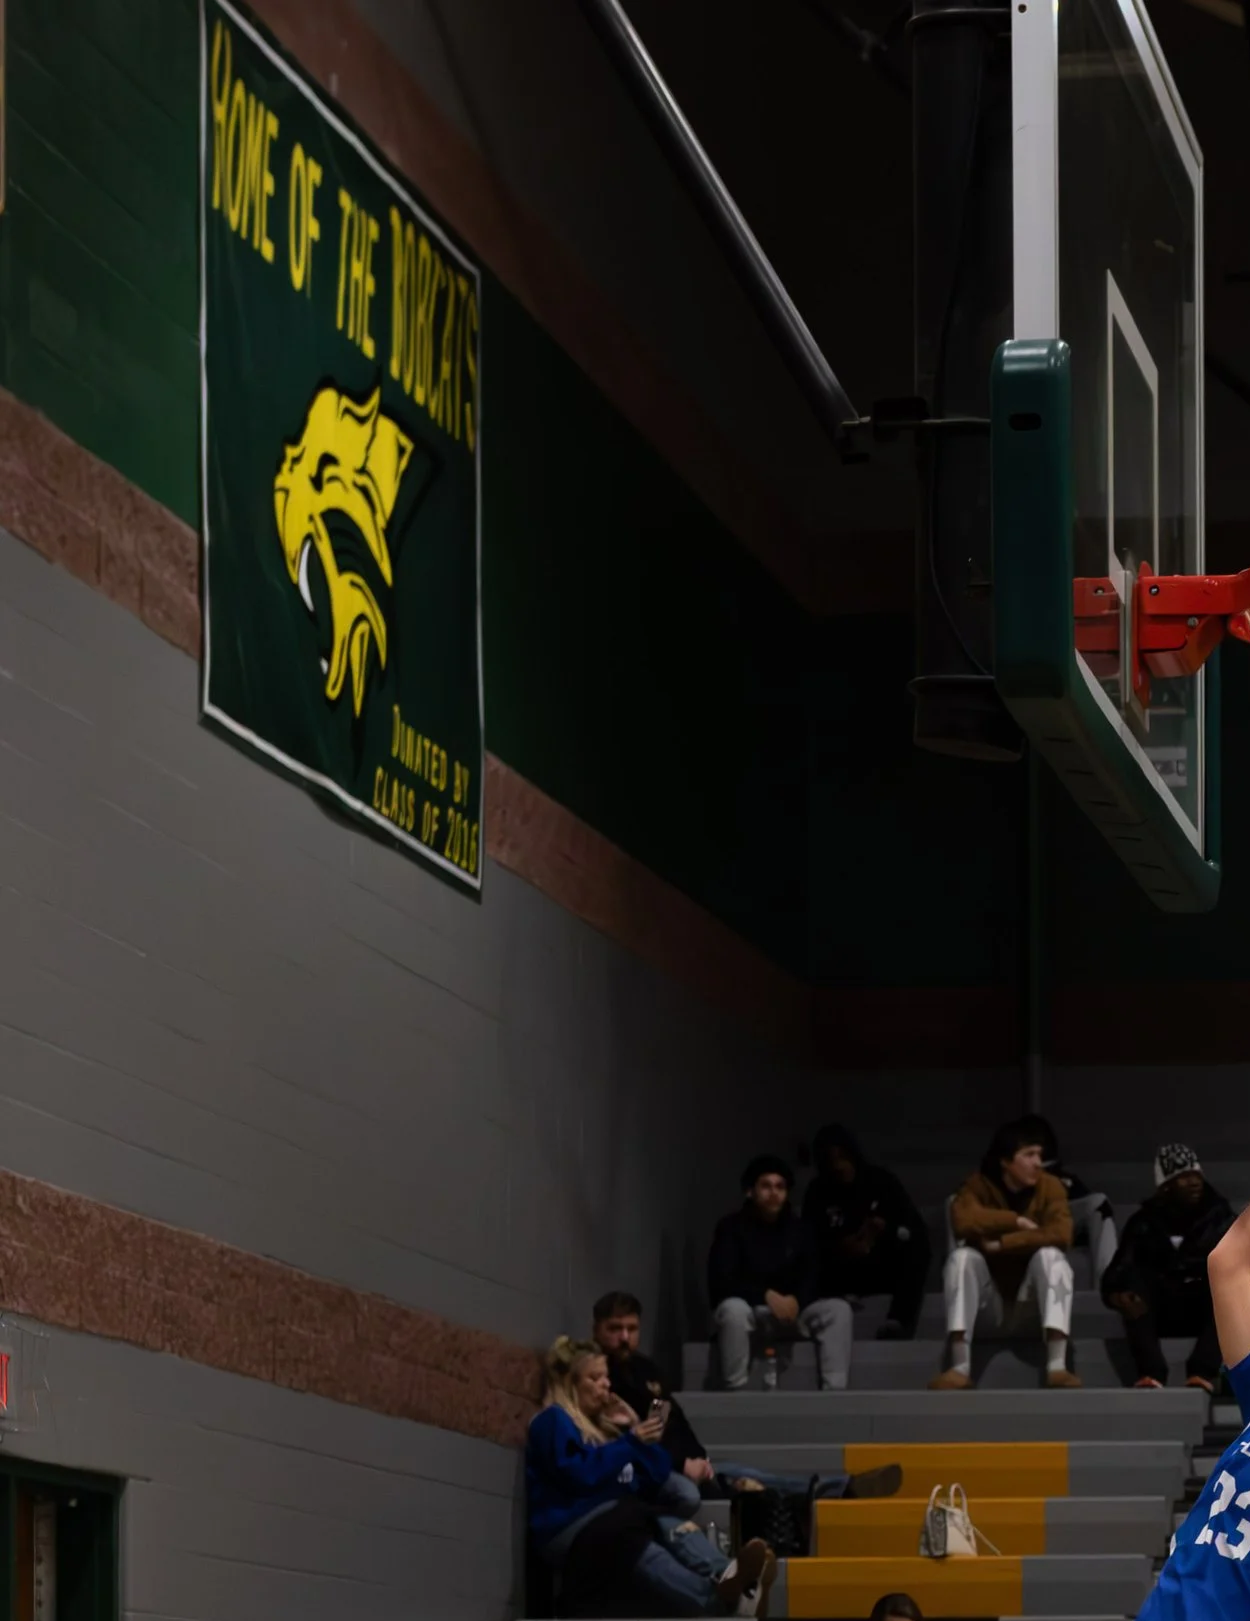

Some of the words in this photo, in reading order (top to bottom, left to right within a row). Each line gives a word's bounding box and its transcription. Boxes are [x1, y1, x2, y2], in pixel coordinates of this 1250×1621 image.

[211, 18, 279, 265] HOME
[289, 141, 323, 298] OF
[336, 186, 380, 361] THE
[389, 204, 478, 455] BOBCATS
[373, 766, 416, 832] CLASS
[421, 800, 441, 849] OF
[391, 703, 448, 792] DONATED
[453, 760, 471, 808] BY
